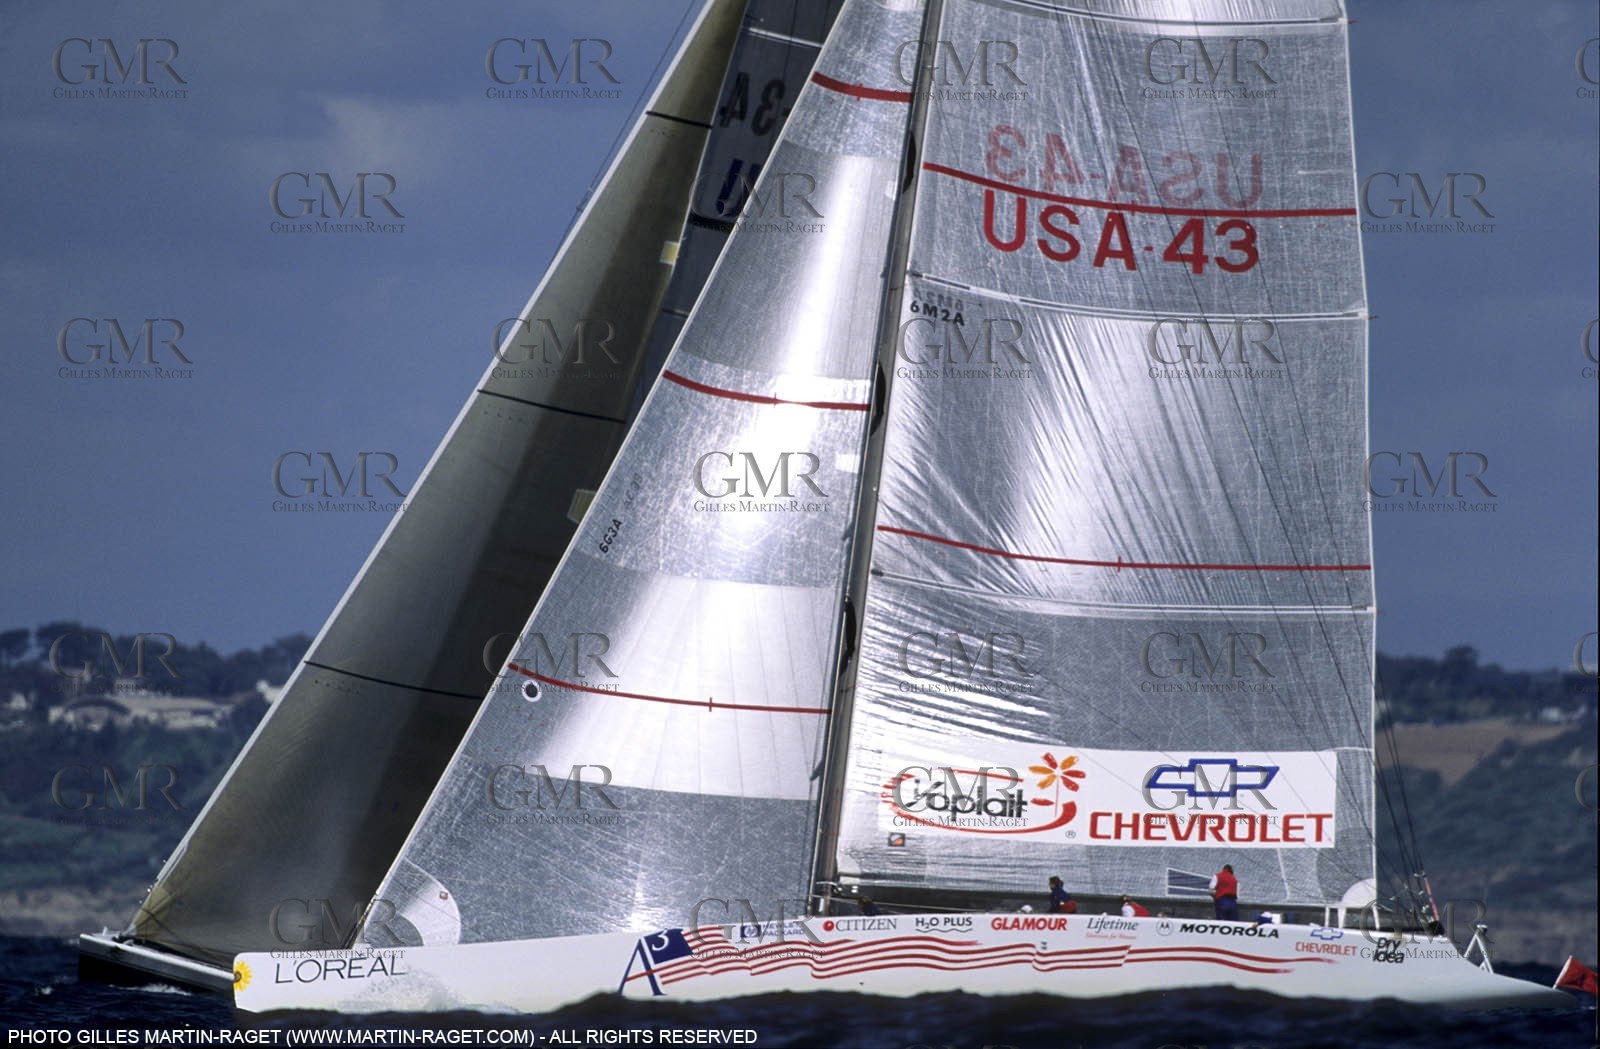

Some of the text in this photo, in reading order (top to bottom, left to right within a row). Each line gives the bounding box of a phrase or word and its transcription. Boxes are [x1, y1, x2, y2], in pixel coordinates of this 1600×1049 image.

[983, 189, 1260, 275] USA-43
[910, 300, 965, 326] 6M2A
[1089, 811, 1334, 843] CHEVROLET
[835, 918, 898, 932] CITIZEN
[943, 917, 973, 928] PLUS
[991, 917, 1068, 931] GLAMOUR
[1087, 917, 1139, 934] Lifetime
[1179, 923, 1280, 939] MOTOROLA
[1295, 941, 1358, 957] CHEVROLET
[1376, 937, 1402, 951] Dry
